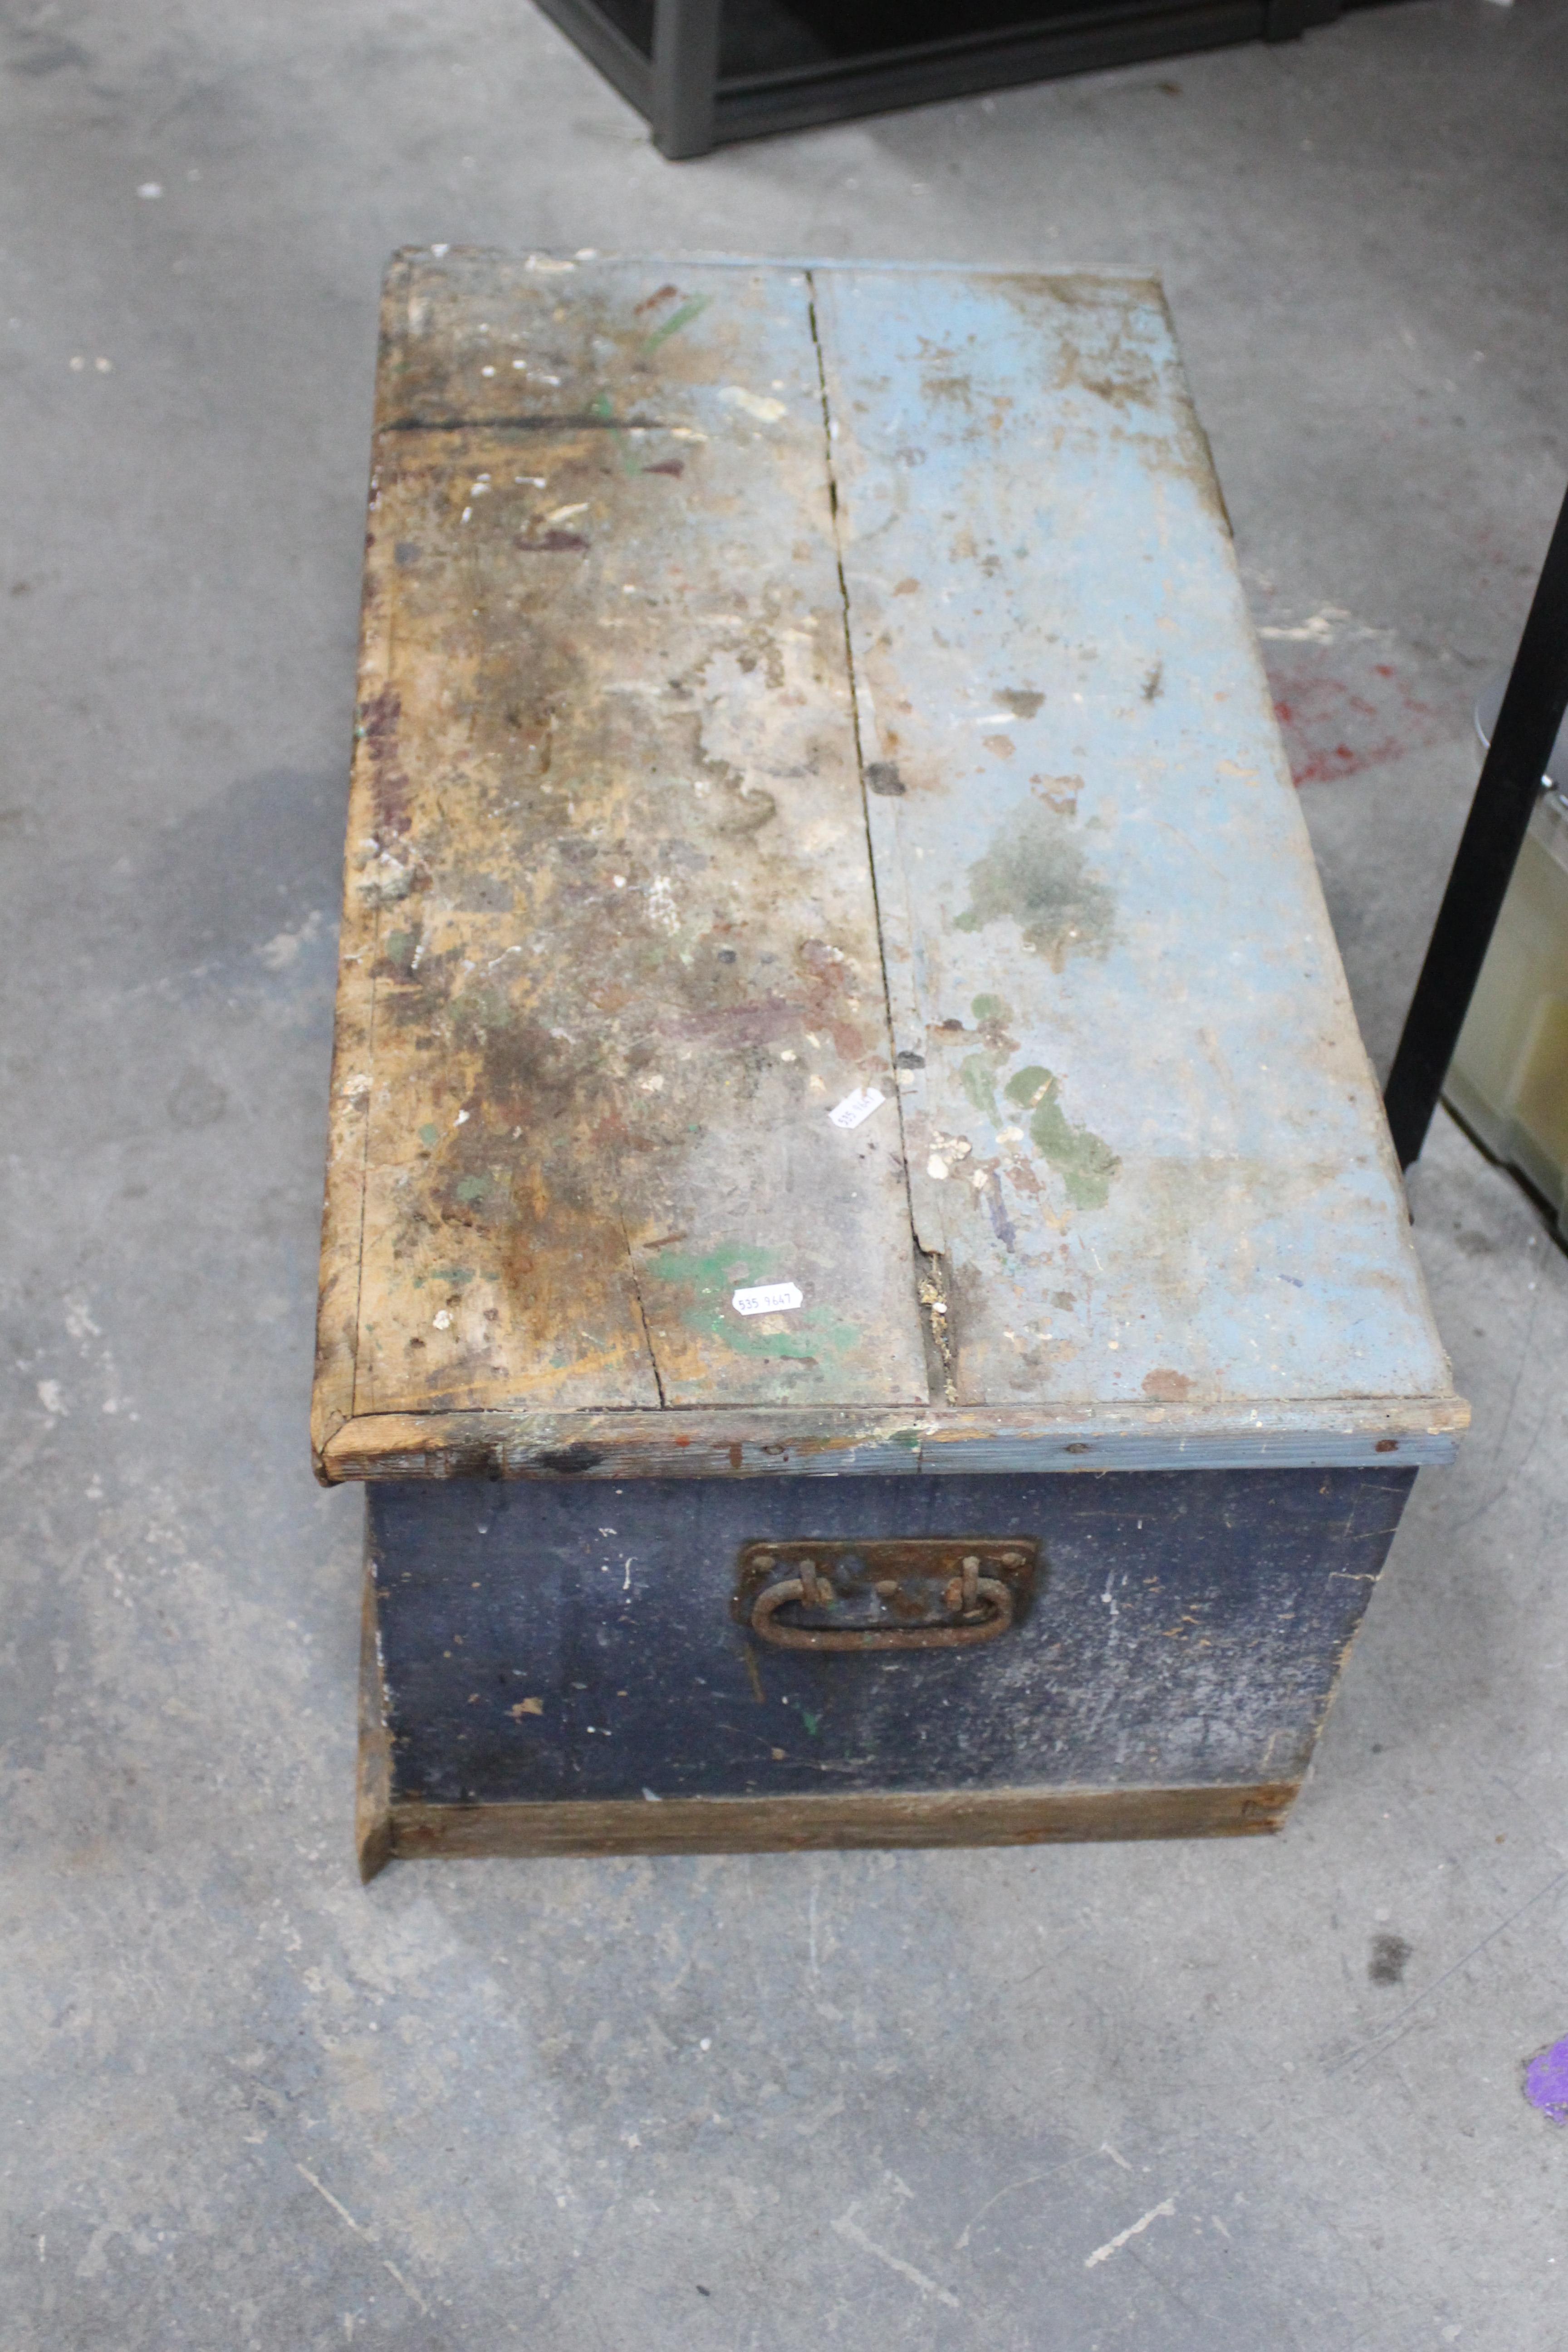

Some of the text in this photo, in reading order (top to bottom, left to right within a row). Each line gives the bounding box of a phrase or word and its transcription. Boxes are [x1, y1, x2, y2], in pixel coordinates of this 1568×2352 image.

[838, 1111, 857, 1125] 535
[738, 1293, 791, 1310] 535 9647
